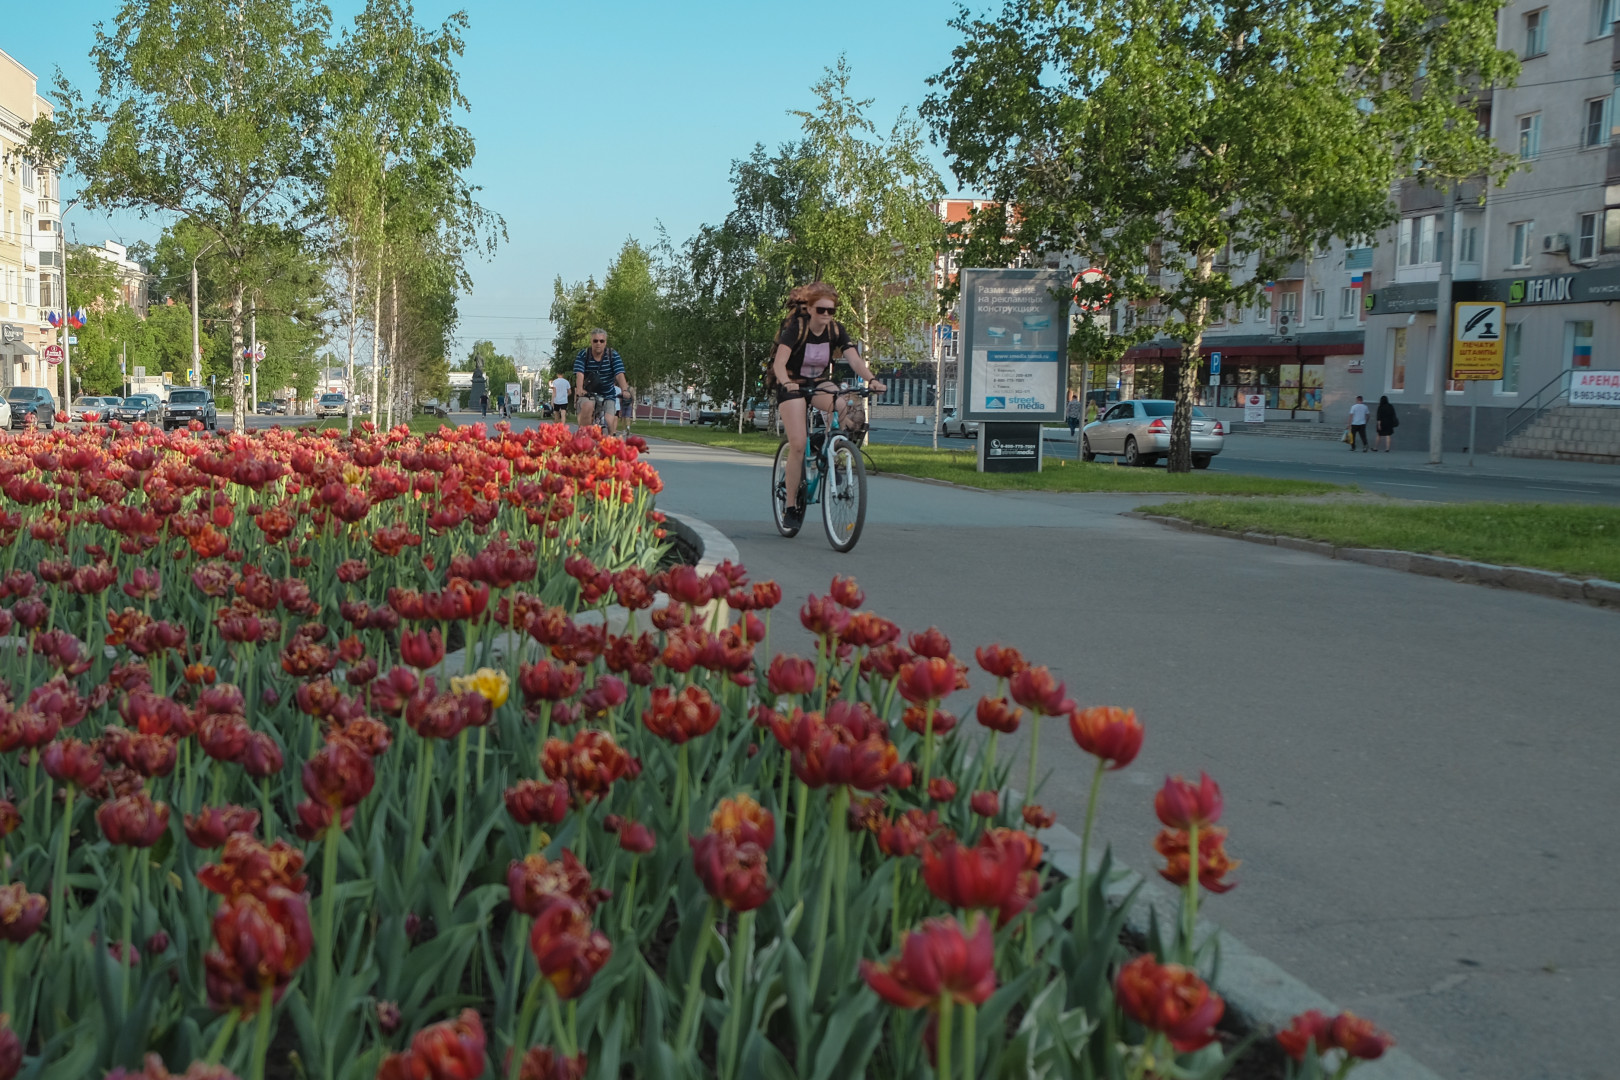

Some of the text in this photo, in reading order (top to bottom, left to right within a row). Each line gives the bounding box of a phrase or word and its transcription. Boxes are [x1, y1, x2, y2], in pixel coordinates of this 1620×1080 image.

[978, 285, 1036, 296] Размещение
[1527, 277, 1574, 302] ПЕПЛОС
[992, 296, 1043, 304] рекламных
[978, 305, 1041, 314] конструкциях
[1213, 355, 1219, 371] P
[1580, 375, 1620, 388] АРЕНД
[1017, 402, 1045, 410] media
